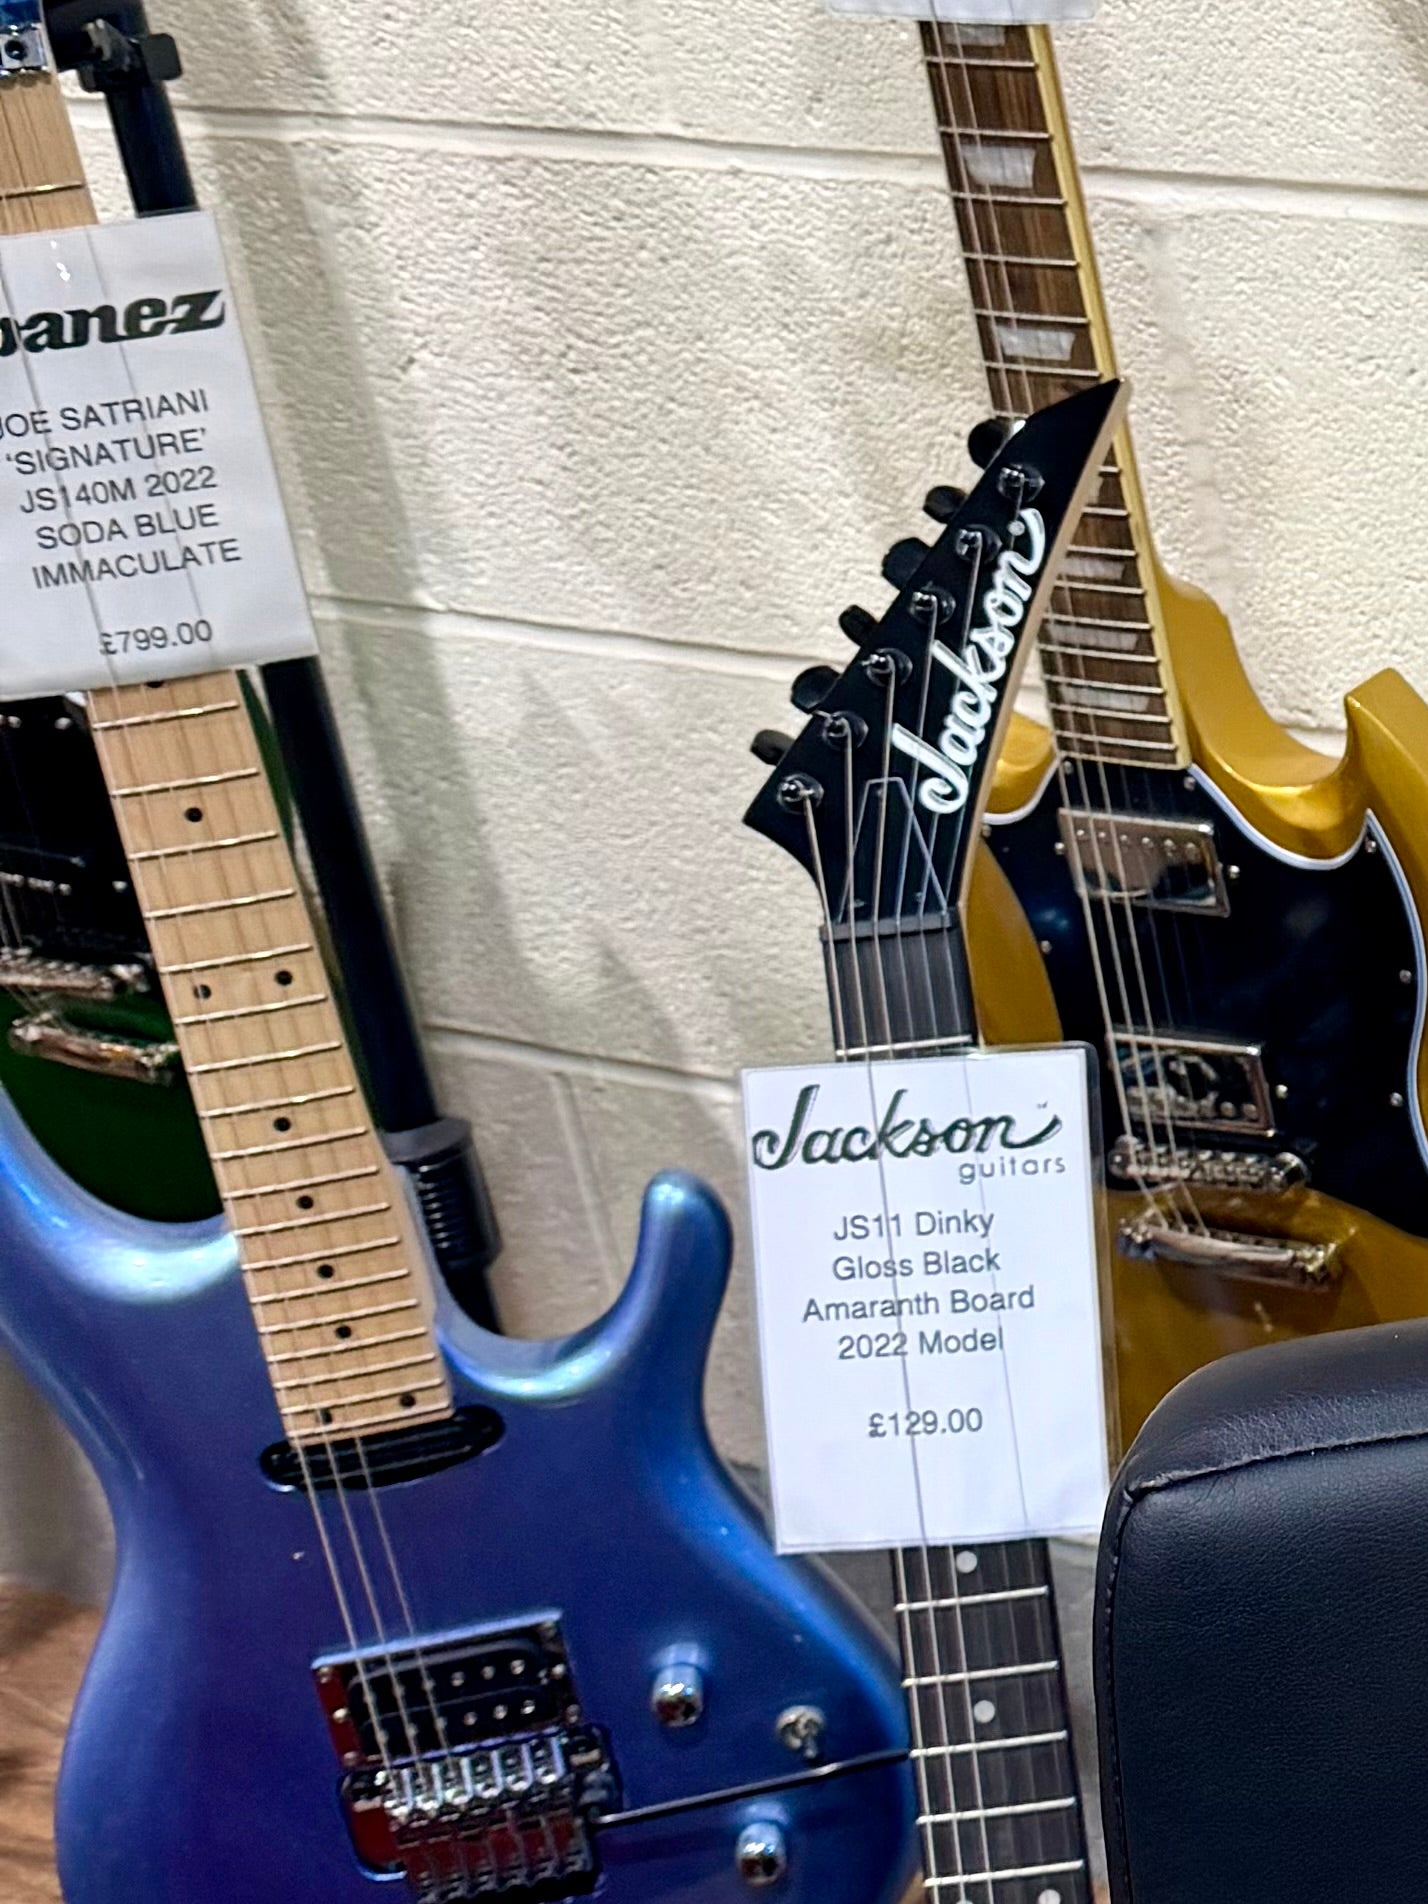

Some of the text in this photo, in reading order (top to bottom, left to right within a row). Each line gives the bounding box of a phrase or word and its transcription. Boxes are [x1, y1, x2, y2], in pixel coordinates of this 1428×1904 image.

[60, 389, 209, 431] SATRIANI
[20, 465, 218, 515] JS140M 2022
[37, 503, 220, 551] SODA BLUE
[33, 537, 242, 589] IMMACULATE
[99, 619, 213, 656] £799.00
[892, 508, 1046, 813] Jackson
[752, 1084, 1063, 1170] Jackson
[959, 1153, 1067, 1185] guitars
[833, 1210, 995, 1241] JS11 Dinky
[832, 1247, 1001, 1281] Gloss Black
[802, 1285, 1035, 1324] Amaranth Board
[837, 1327, 1003, 1360] 2022 Model
[868, 1408, 983, 1438] £129.00
